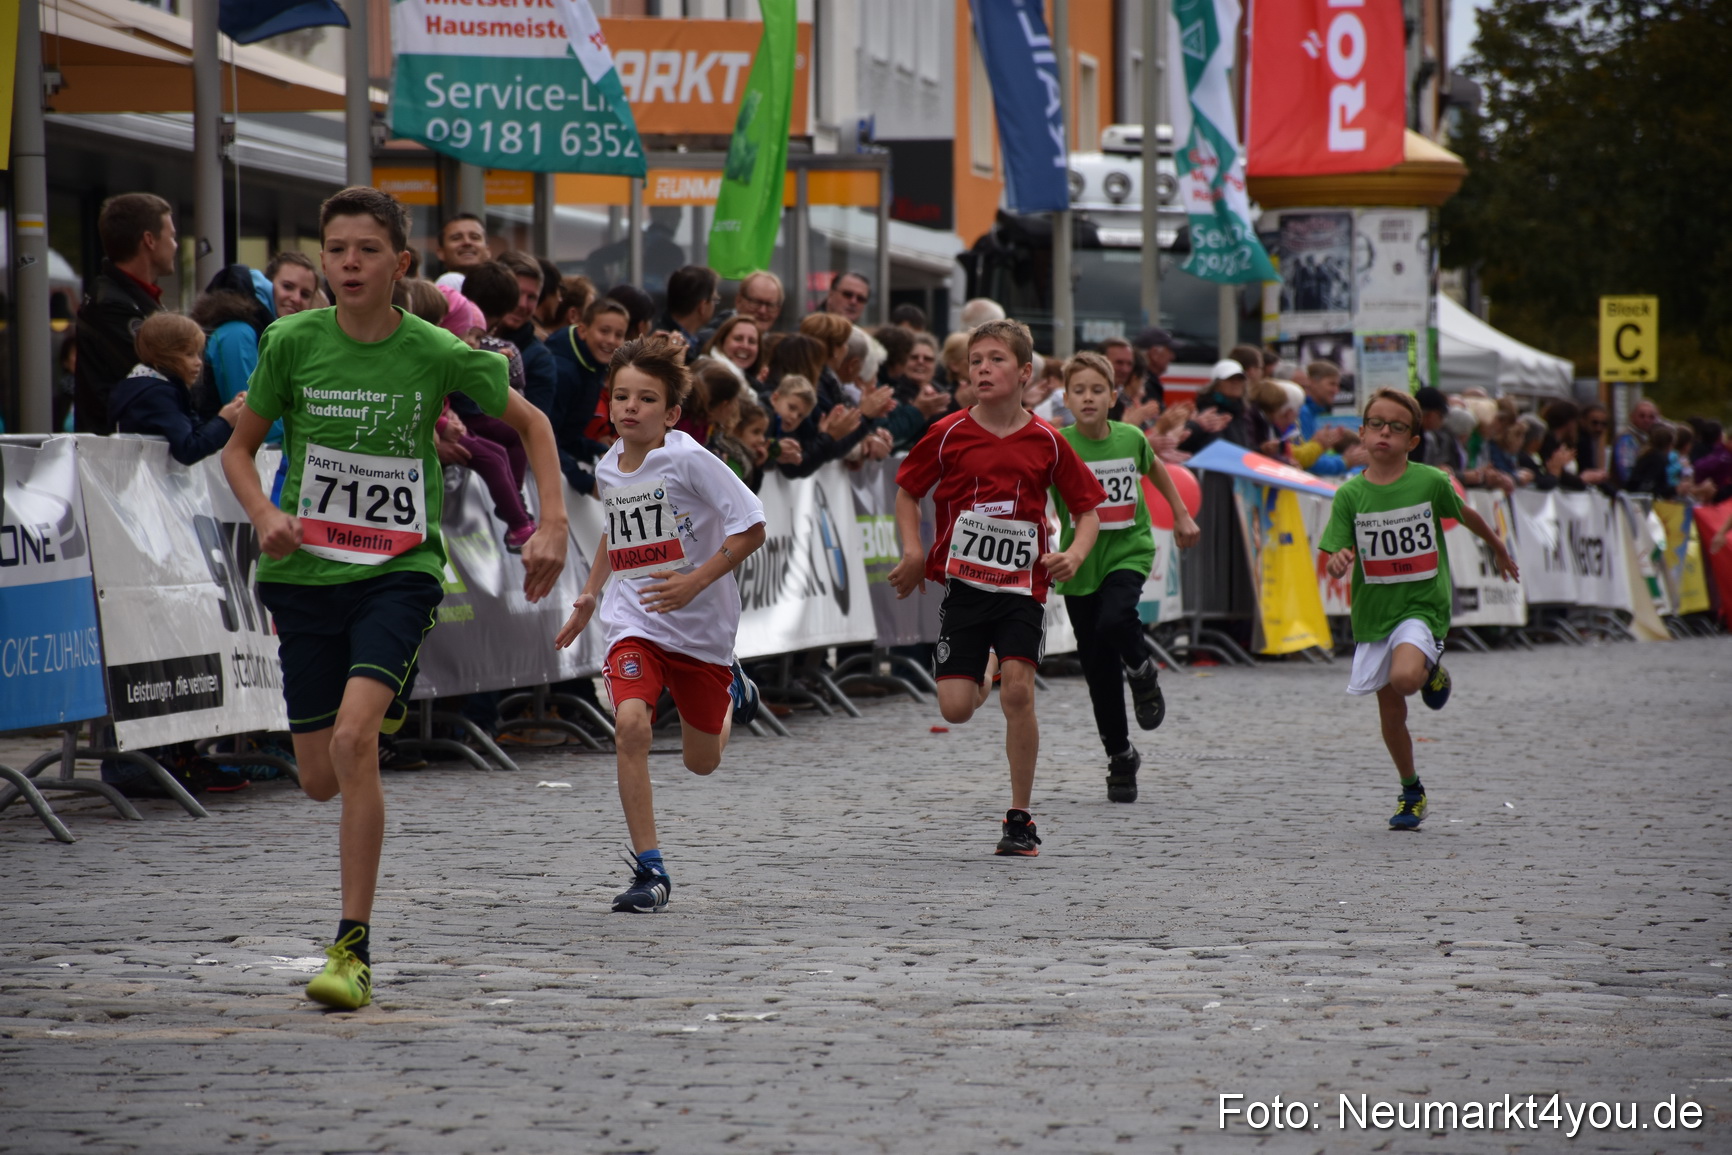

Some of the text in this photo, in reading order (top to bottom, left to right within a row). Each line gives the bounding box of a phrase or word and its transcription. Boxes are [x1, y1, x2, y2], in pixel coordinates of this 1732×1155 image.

[1300, 0, 1367, 152] RÖ
[425, 73, 614, 112] Service-Li
[426, 118, 542, 156] 09181
[1614, 323, 1642, 363] C
[303, 387, 388, 402] Neumarkter
[306, 403, 370, 421] Stadtlauf
[307, 455, 405, 480] PARTL Neumarkt
[1094, 466, 1128, 476] Neumarkt
[314, 474, 417, 526] 7129
[616, 491, 651, 506] Neumarkt
[984, 505, 1003, 513] DEHN
[958, 516, 1027, 537] PARTL Neumarkt
[1356, 513, 1421, 528] PARTL Neumarkt
[326, 527, 393, 551] Valentin
[962, 529, 1032, 569] 7005
[1364, 522, 1432, 557] 7083
[611, 544, 667, 570] MARLON
[1392, 562, 1413, 573] Tim
[958, 563, 1020, 585] Maximilian
